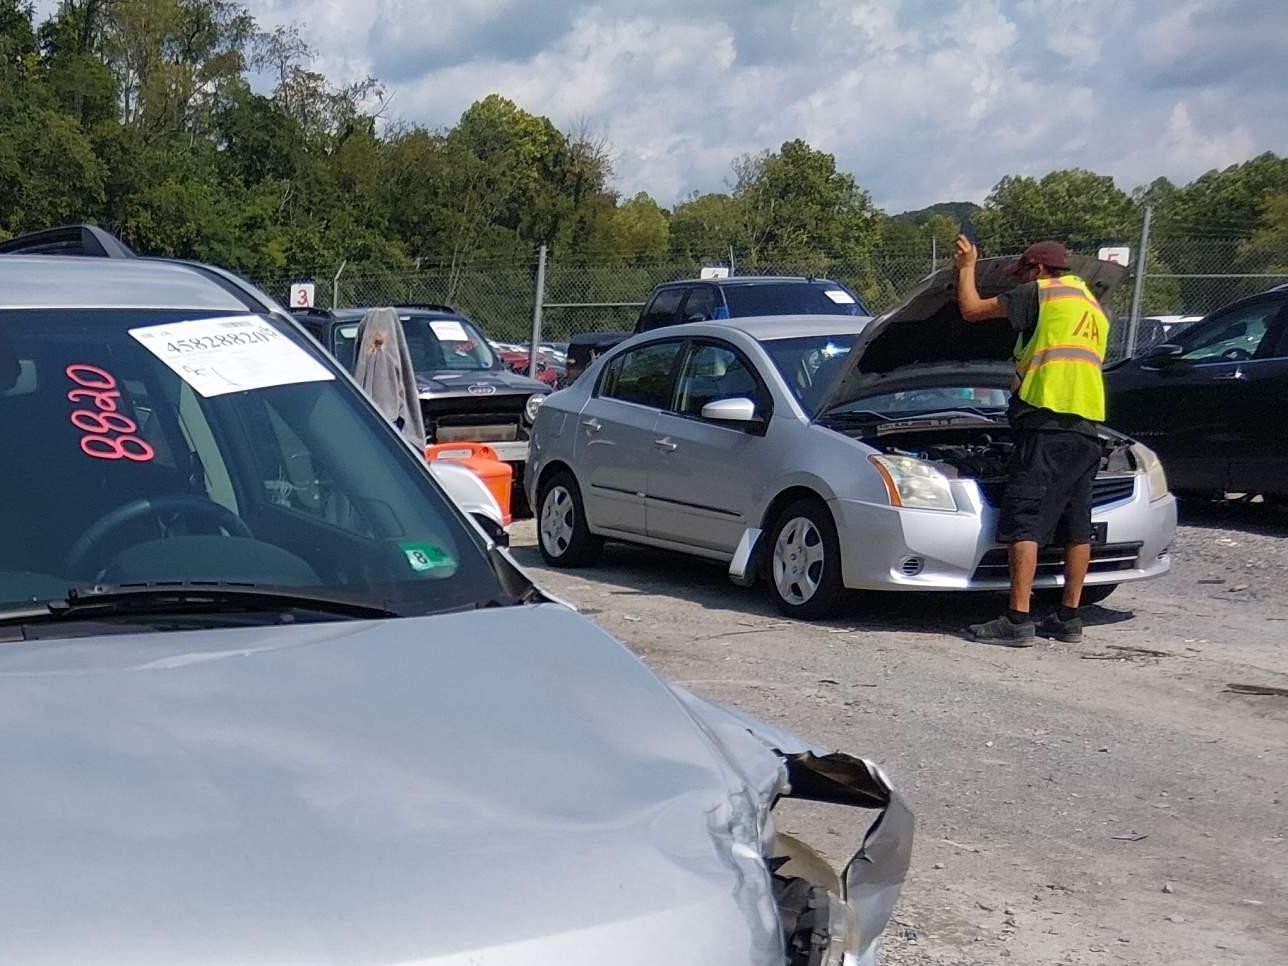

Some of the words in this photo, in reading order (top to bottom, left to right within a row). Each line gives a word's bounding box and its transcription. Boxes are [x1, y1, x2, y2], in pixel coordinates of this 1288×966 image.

[297, 289, 308, 305] 3
[166, 329, 271, 354] 45828820
[65, 364, 154, 461] 8820
